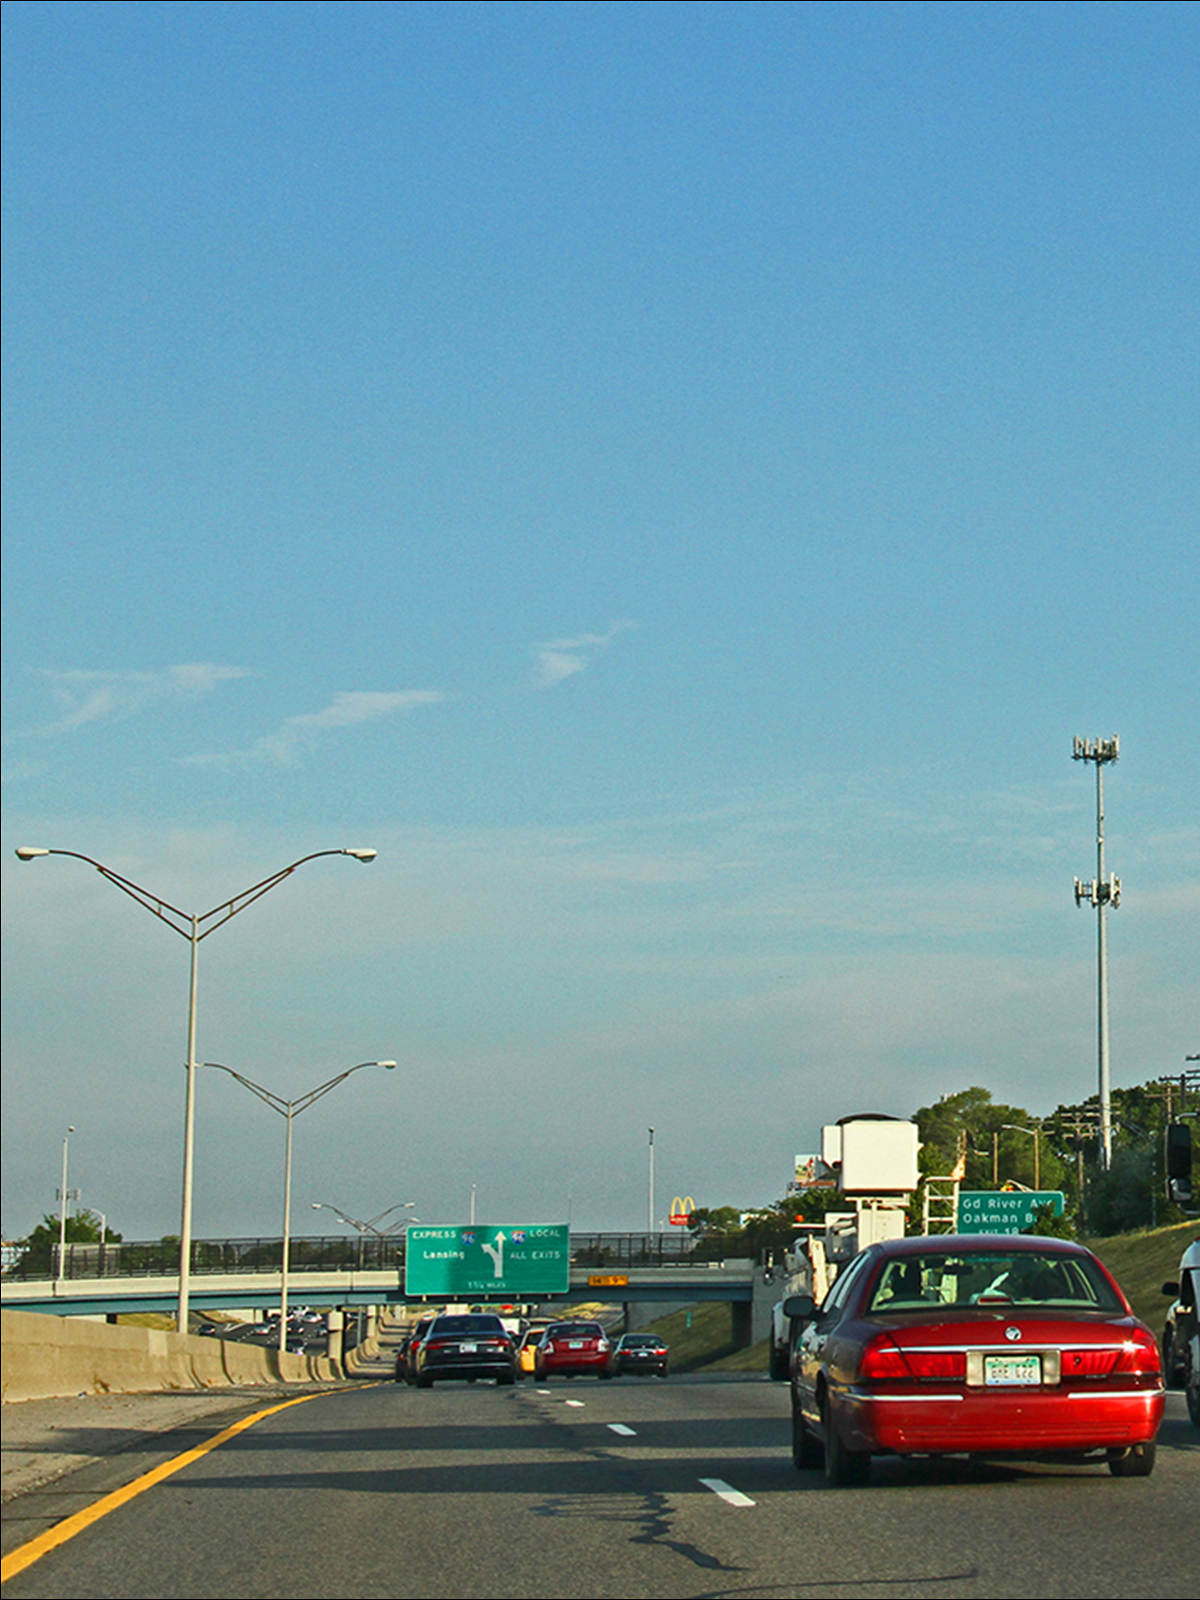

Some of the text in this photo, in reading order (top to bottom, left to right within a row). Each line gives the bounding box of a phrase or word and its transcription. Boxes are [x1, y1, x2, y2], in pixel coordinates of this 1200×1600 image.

[963, 1198, 981, 1209] Gd
[988, 1198, 1022, 1209] River
[963, 1213, 1018, 1223] Oakman
[412, 1230, 475, 1243] EXPRESS 96
[512, 1229, 561, 1243] 96 LOCAL
[423, 1250, 465, 1259] Lansing
[510, 1251, 561, 1260] ALL EXITS
